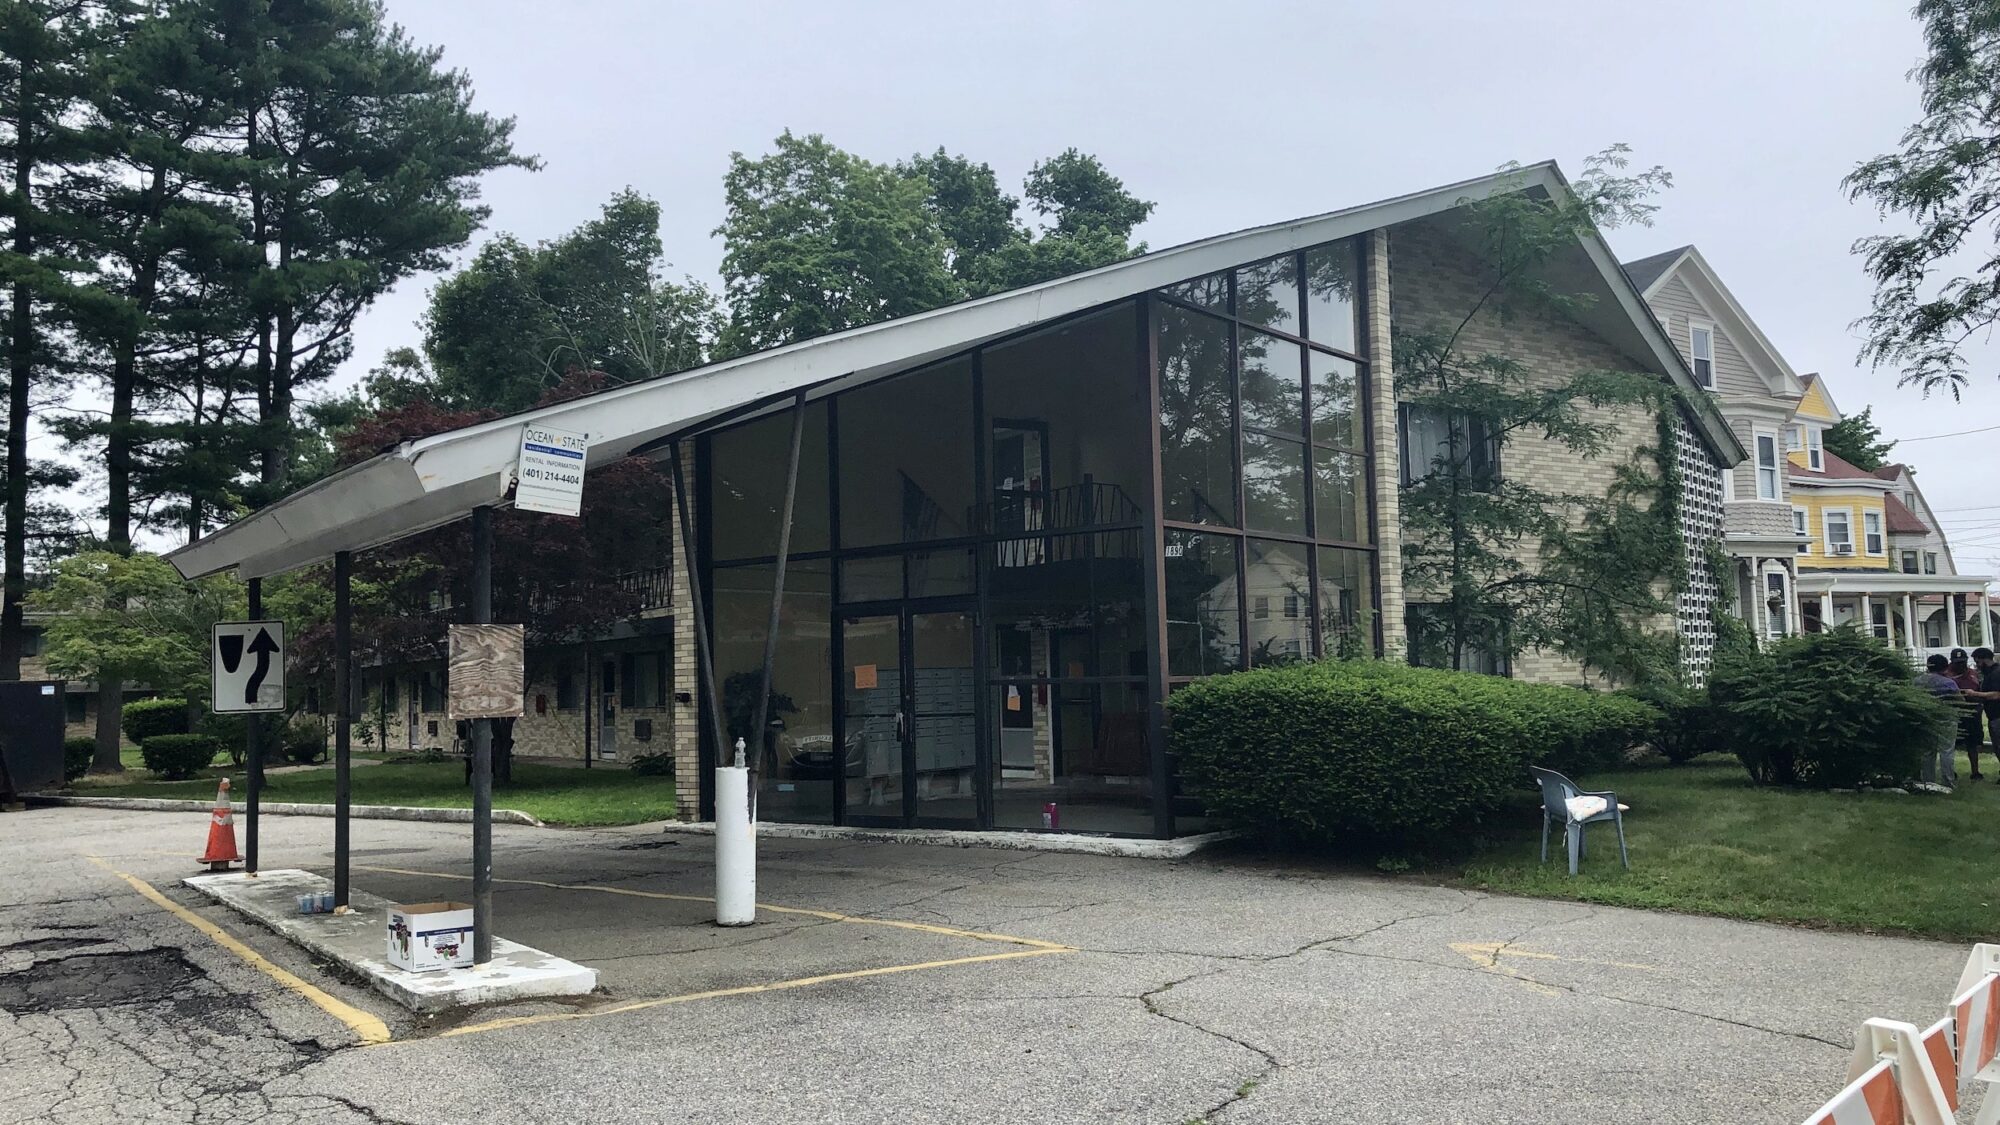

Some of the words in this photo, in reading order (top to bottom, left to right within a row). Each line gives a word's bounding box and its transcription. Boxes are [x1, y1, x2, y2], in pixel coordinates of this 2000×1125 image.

[526, 429, 554, 444] OCEAN
[562, 436, 586, 451] STATE
[525, 456, 544, 465] RENTAL
[547, 460, 580, 471] INFORMATION
[523, 467, 544, 481] (401)
[544, 471, 580, 485] 214-4404
